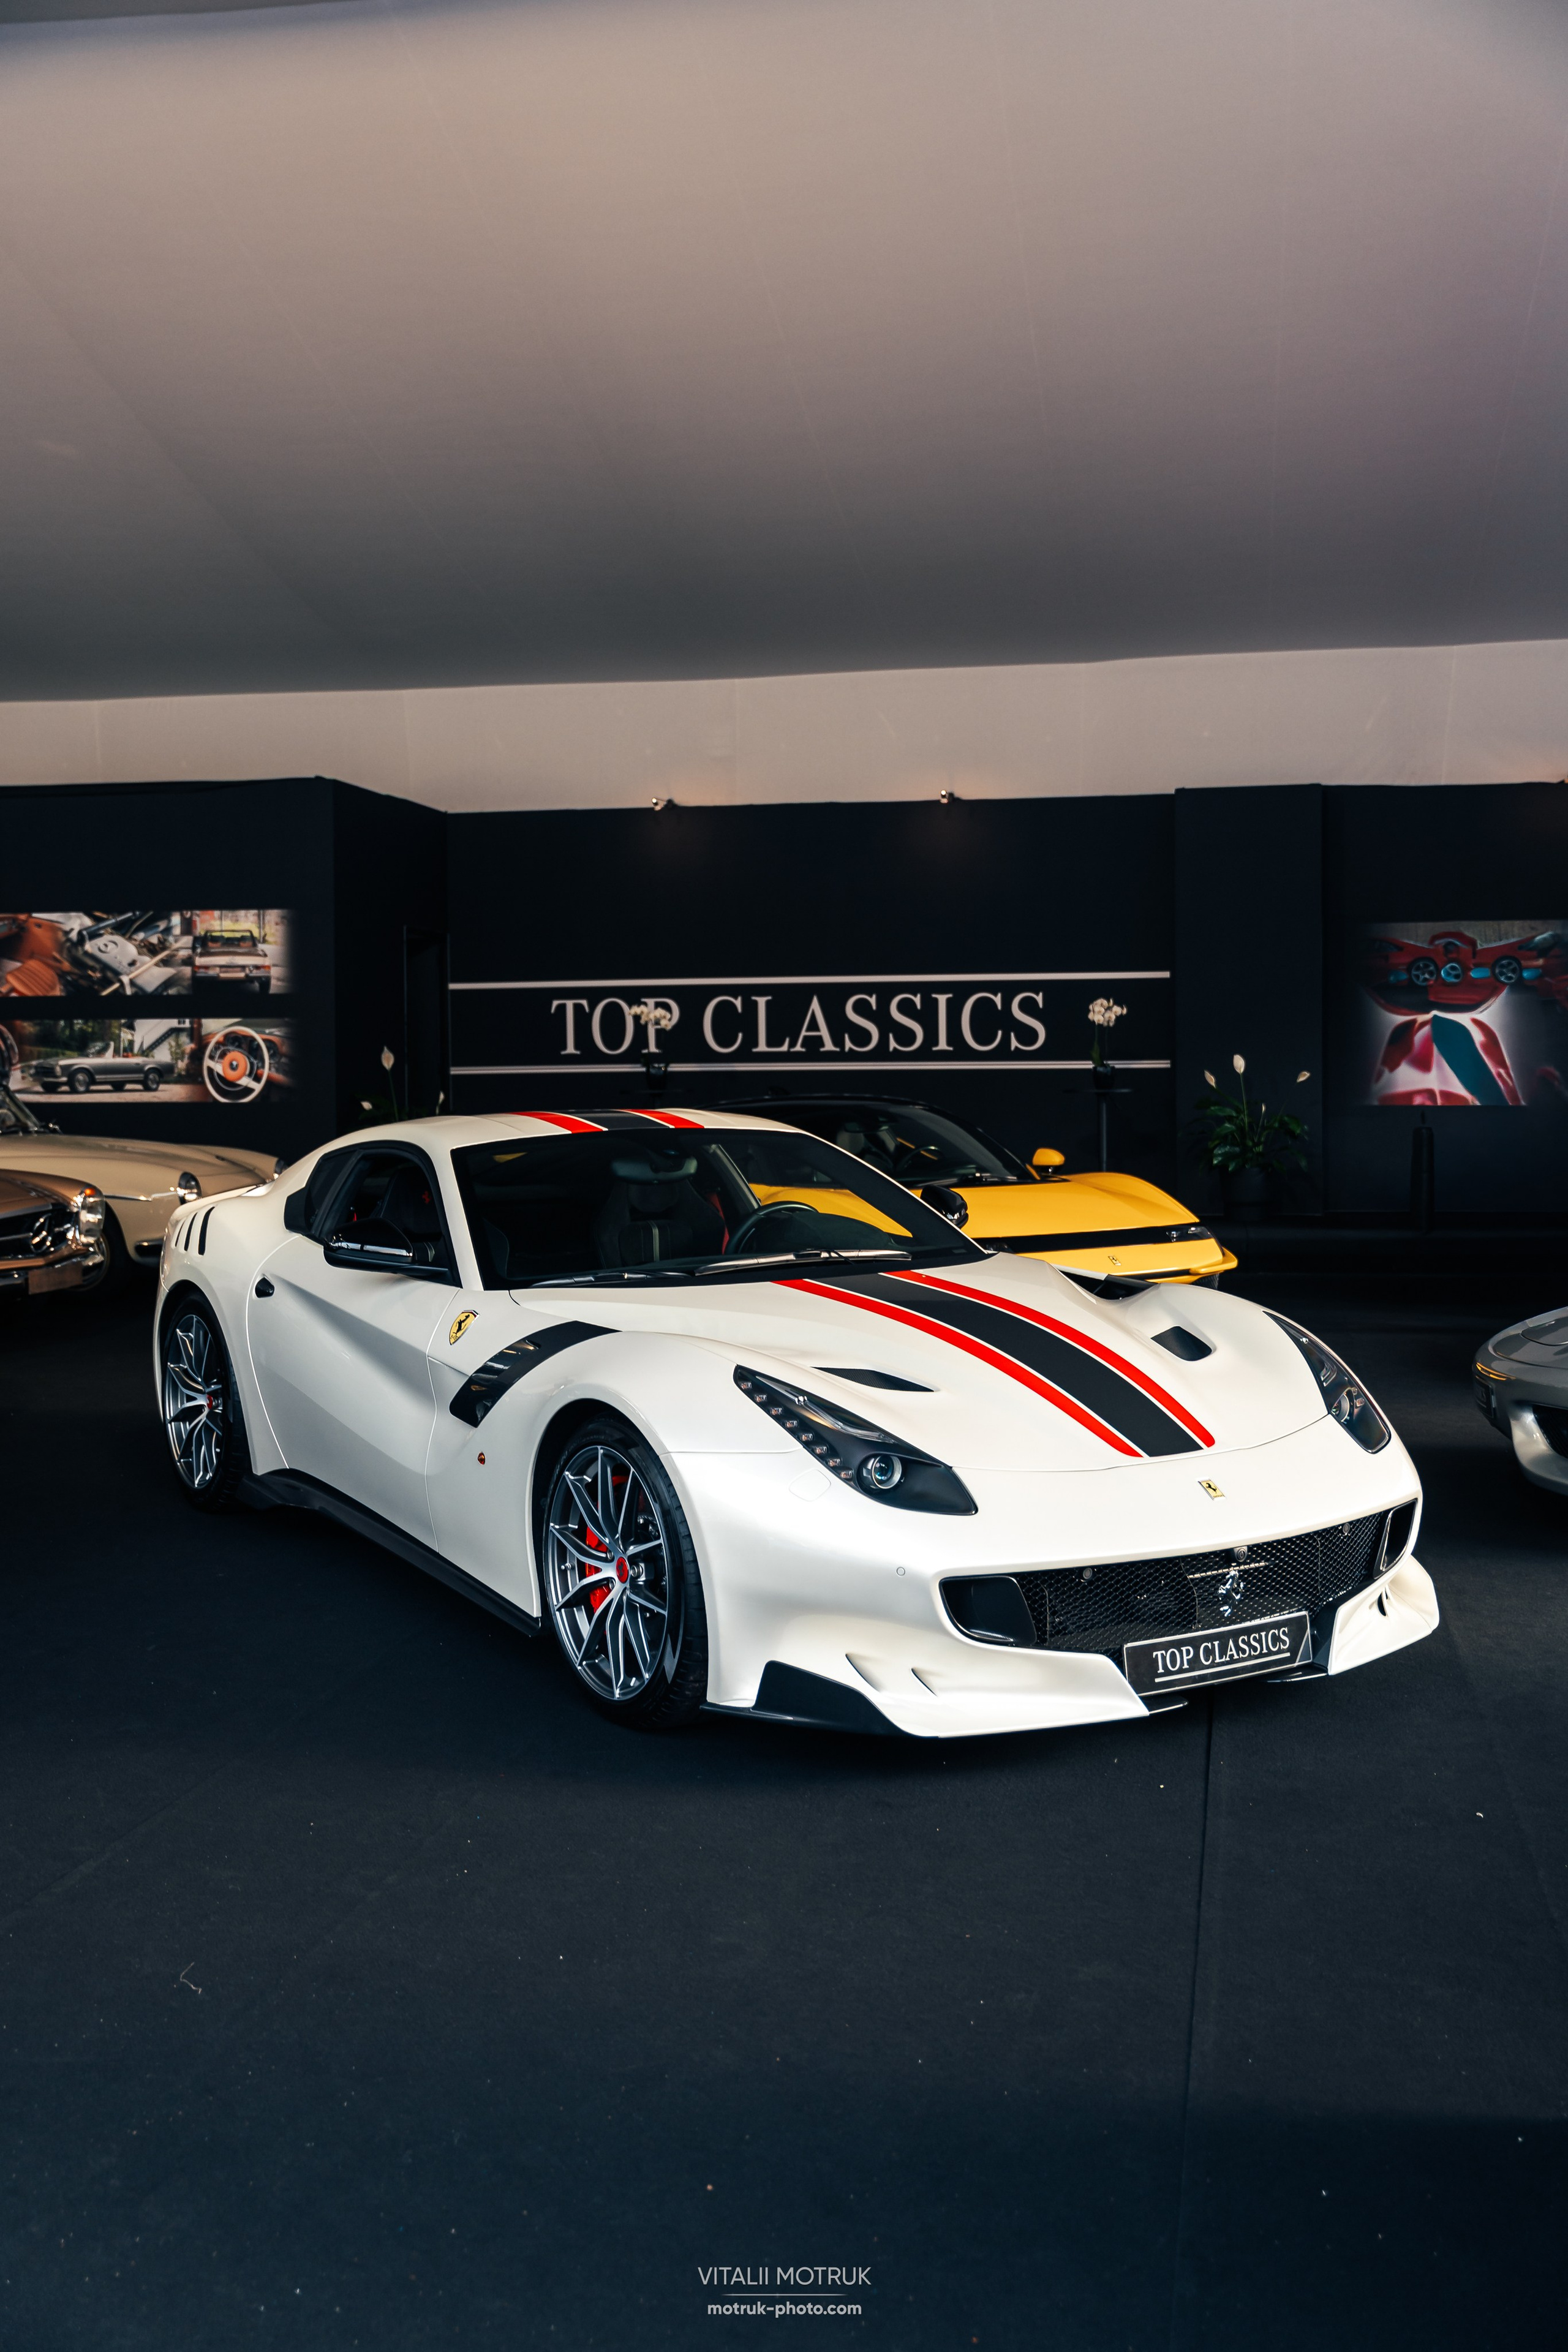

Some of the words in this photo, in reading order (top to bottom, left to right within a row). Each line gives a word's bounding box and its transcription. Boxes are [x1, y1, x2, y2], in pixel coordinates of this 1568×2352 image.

[551, 997, 680, 1055] TOP
[703, 991, 1046, 1054] CLASSICS
[1152, 1645, 1194, 1673] TOP
[1199, 1626, 1291, 1665] CLASSICS
